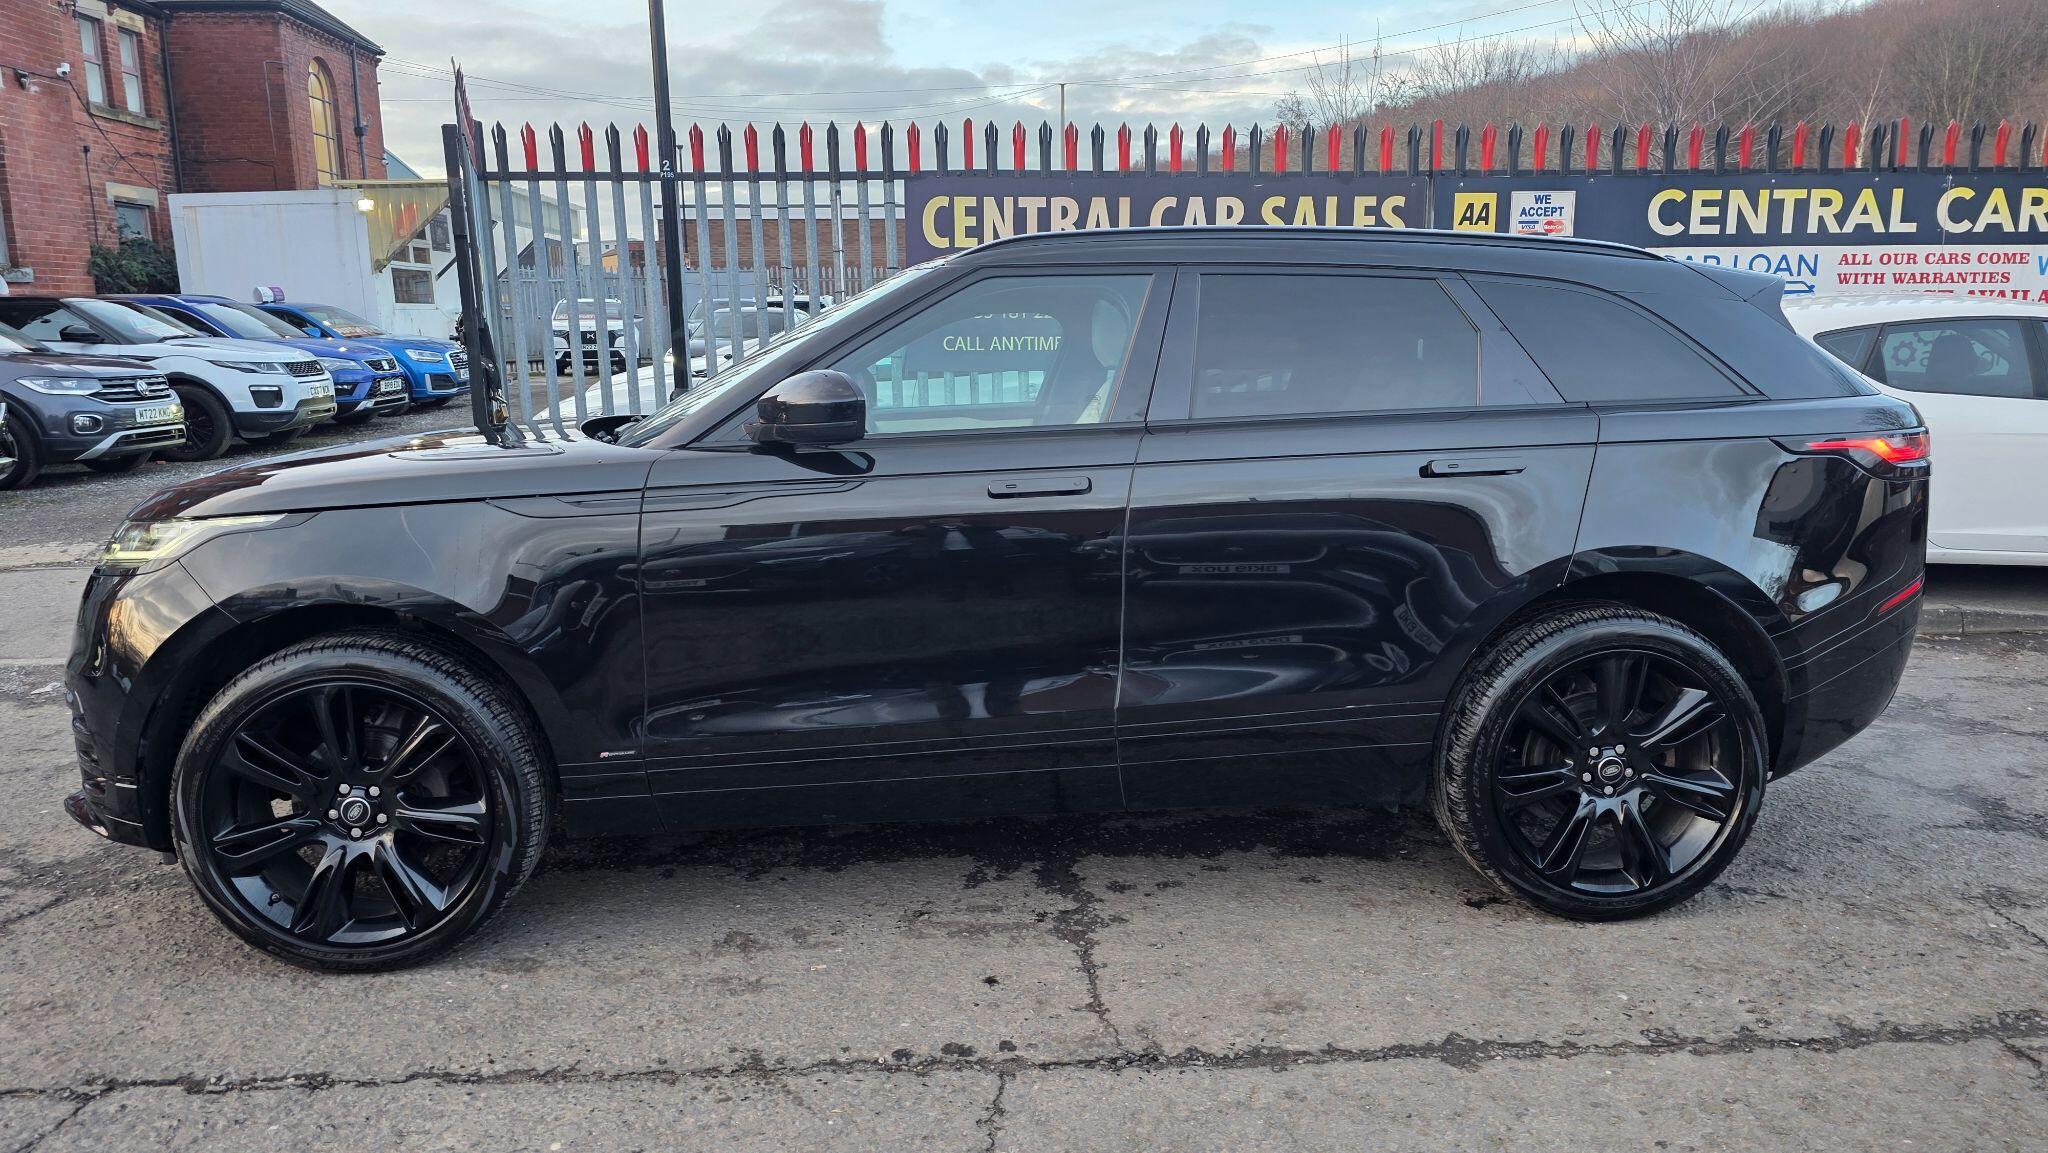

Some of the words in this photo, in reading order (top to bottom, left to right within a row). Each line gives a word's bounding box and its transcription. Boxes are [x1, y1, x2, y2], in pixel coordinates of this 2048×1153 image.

[662, 160, 670, 170] 2
[1534, 194, 1552, 205] WE
[1458, 203, 1490, 226] AA
[1519, 207, 1564, 218] ACCEPT
[1648, 188, 1917, 236] CENTRAL
[1937, 188, 2048, 233] CAR
[1838, 253, 1872, 265] ALL
[1879, 253, 1919, 265] OUR
[1925, 252, 1971, 265] CARS
[1977, 252, 2030, 264] COME
[1837, 272, 1886, 285] WITH
[1892, 271, 2011, 284] WARRANTIES
[943, 336, 985, 351] CALL
